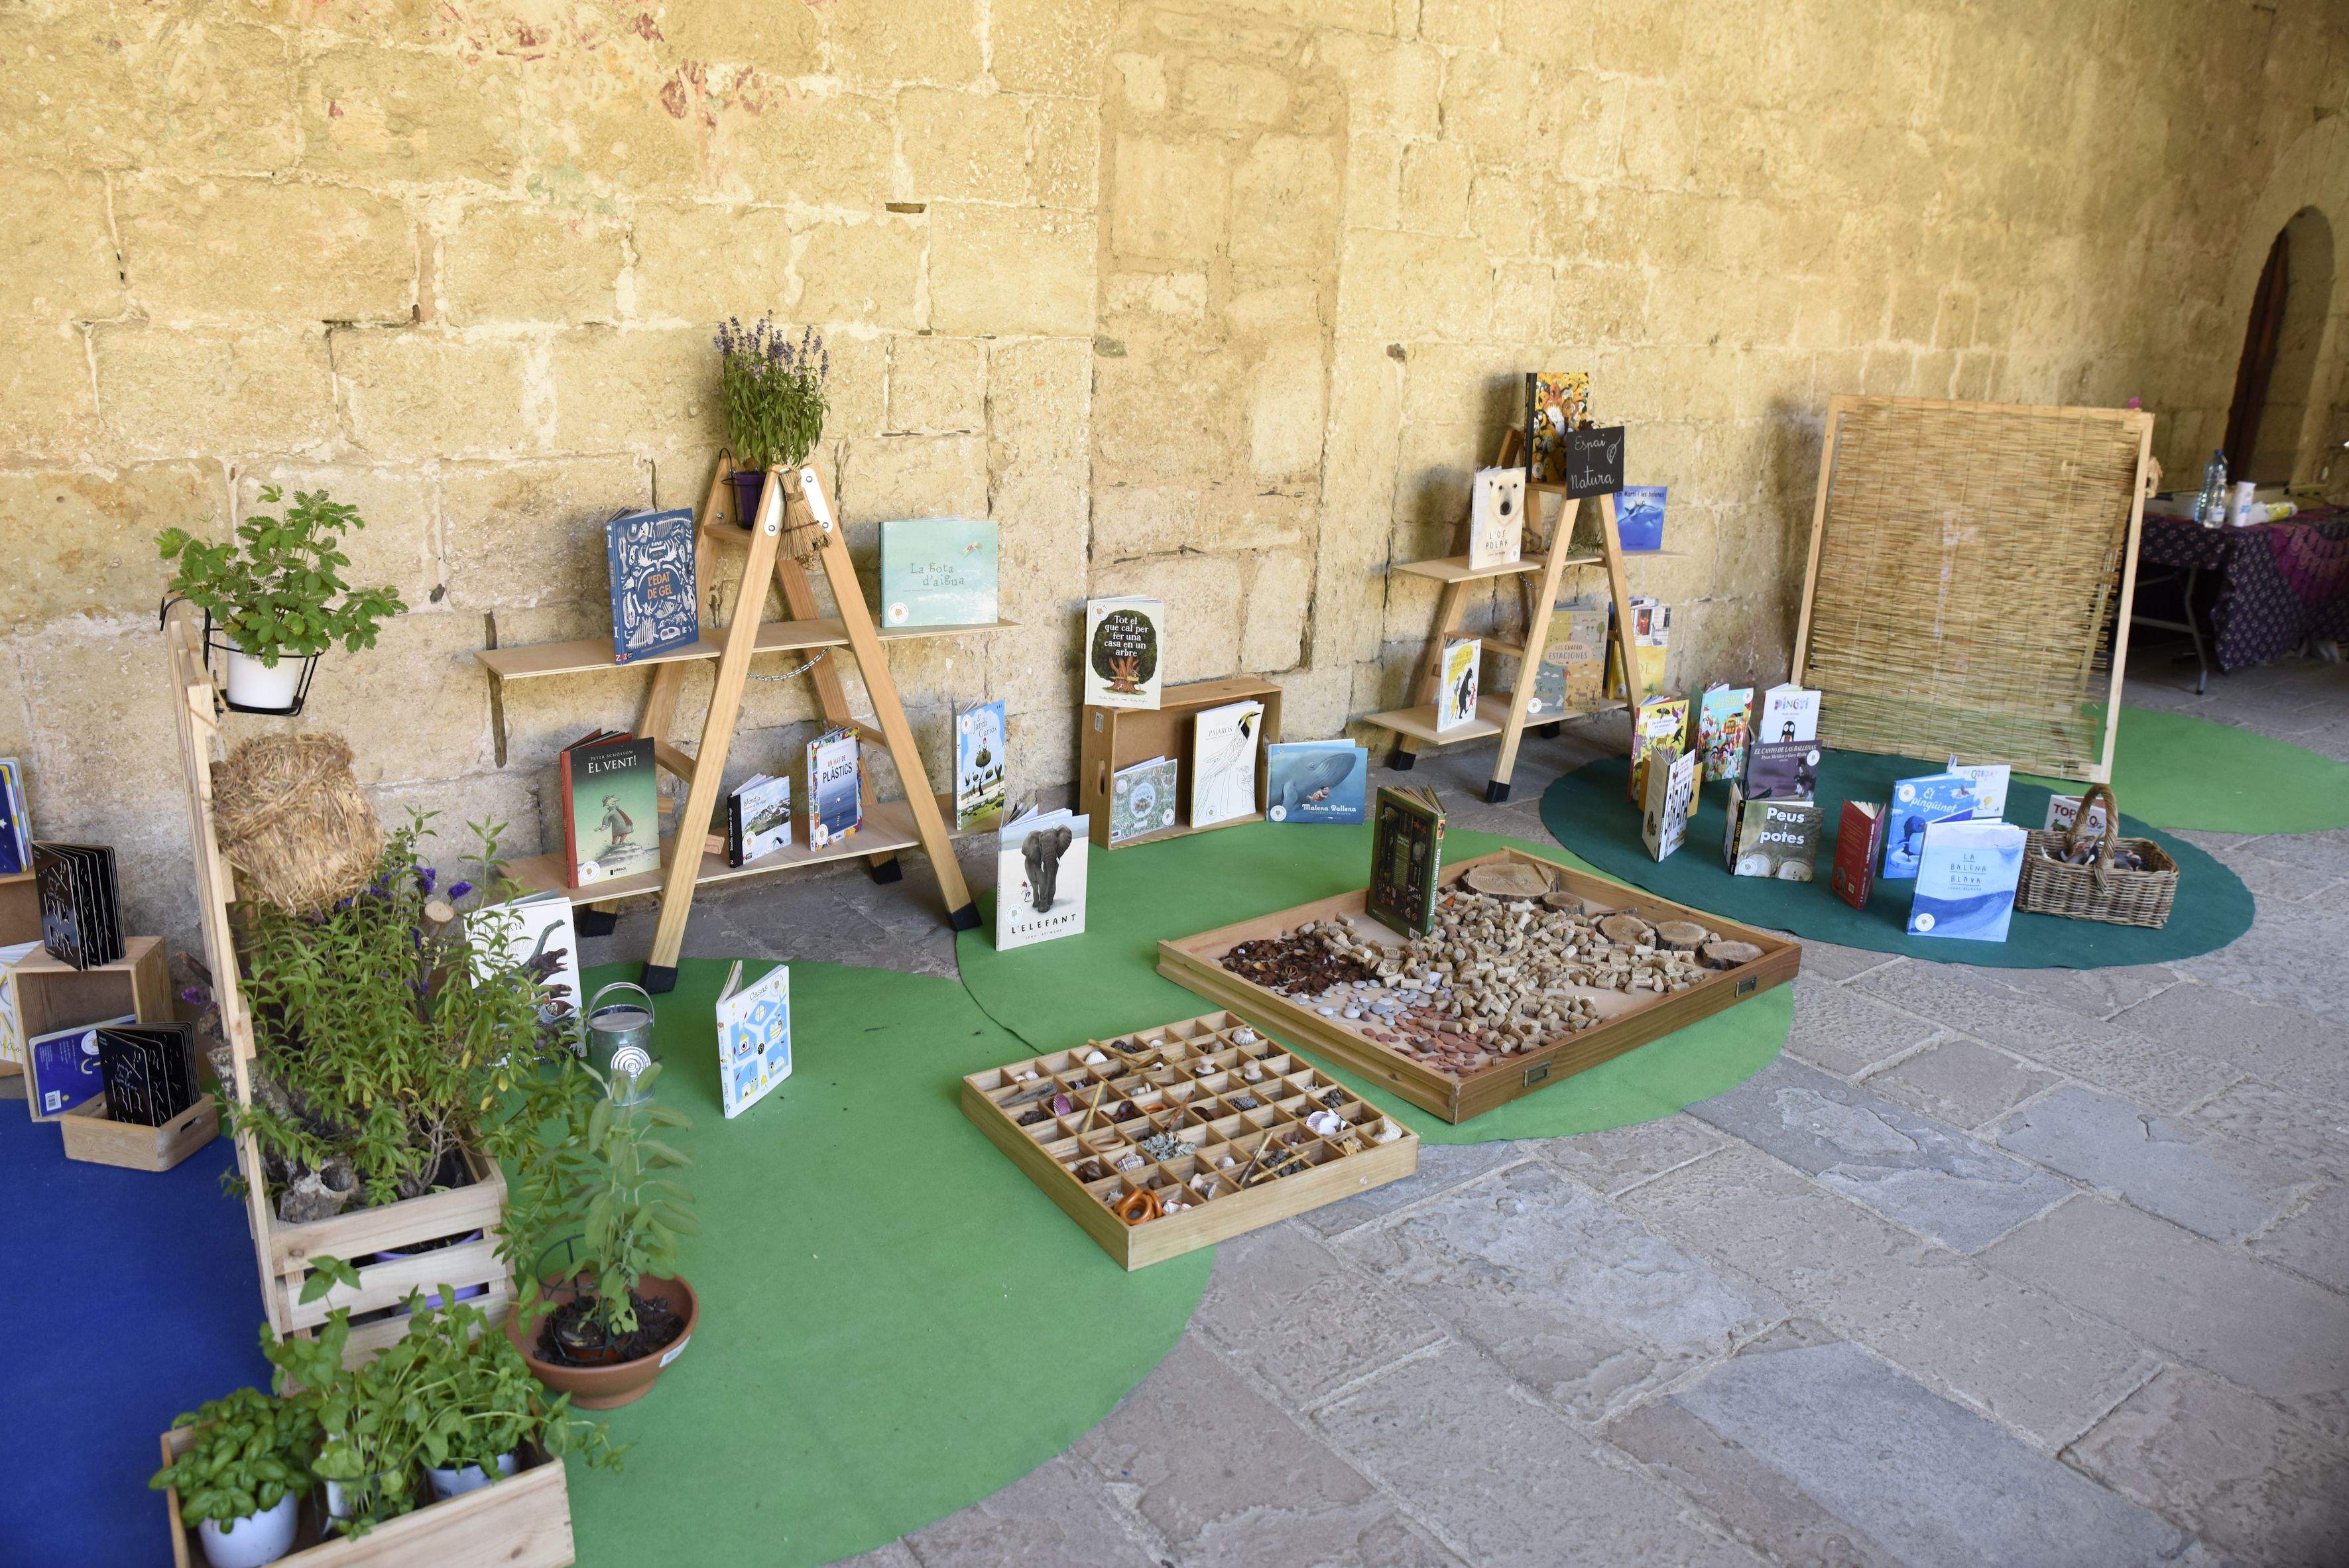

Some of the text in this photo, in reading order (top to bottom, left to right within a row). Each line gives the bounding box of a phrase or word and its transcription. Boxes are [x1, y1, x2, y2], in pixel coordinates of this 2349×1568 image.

[1575, 434, 1606, 461] Espai
[1571, 465, 1614, 490] Natura
[1485, 539, 1508, 550] POLAR
[910, 562, 954, 573] La gota
[648, 572, 670, 587] L'EDAT
[923, 574, 965, 587] d'aigua
[648, 584, 672, 599] DE GEL
[1114, 615, 1128, 624] Tot
[588, 754, 636, 774] EL VENT!
[823, 762, 853, 784] PLÀSTICS
[743, 795, 760, 807] Islandia
[1924, 787, 1935, 800] El
[1909, 798, 1958, 813] pingüinet
[1766, 807, 1805, 823] Peus
[1760, 831, 1805, 845] potes
[1951, 863, 1986, 872] BALENA
[1951, 874, 1981, 884] BLAVA
[1012, 914, 1076, 934] L'ELEFANT
[750, 984, 768, 1000] Casas
